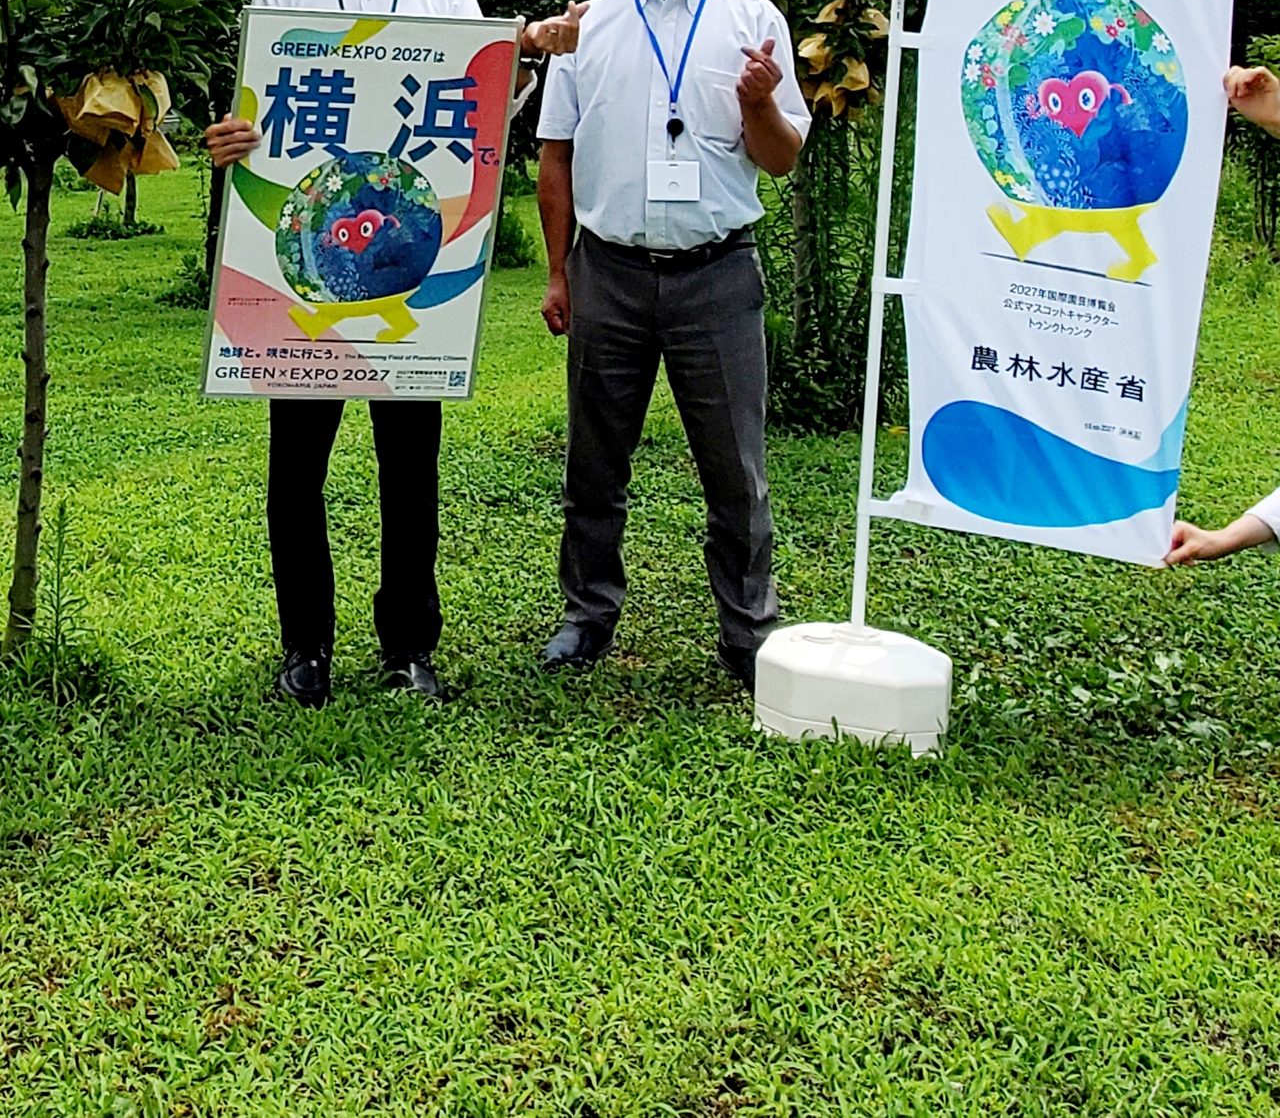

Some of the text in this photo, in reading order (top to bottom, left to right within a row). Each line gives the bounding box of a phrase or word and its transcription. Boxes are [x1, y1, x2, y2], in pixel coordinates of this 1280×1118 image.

[1002, 297, 1120, 327] 公式マスコットキャラクター
[342, 369, 391, 382] 2027
[970, 344, 1148, 403] 農林水産省
